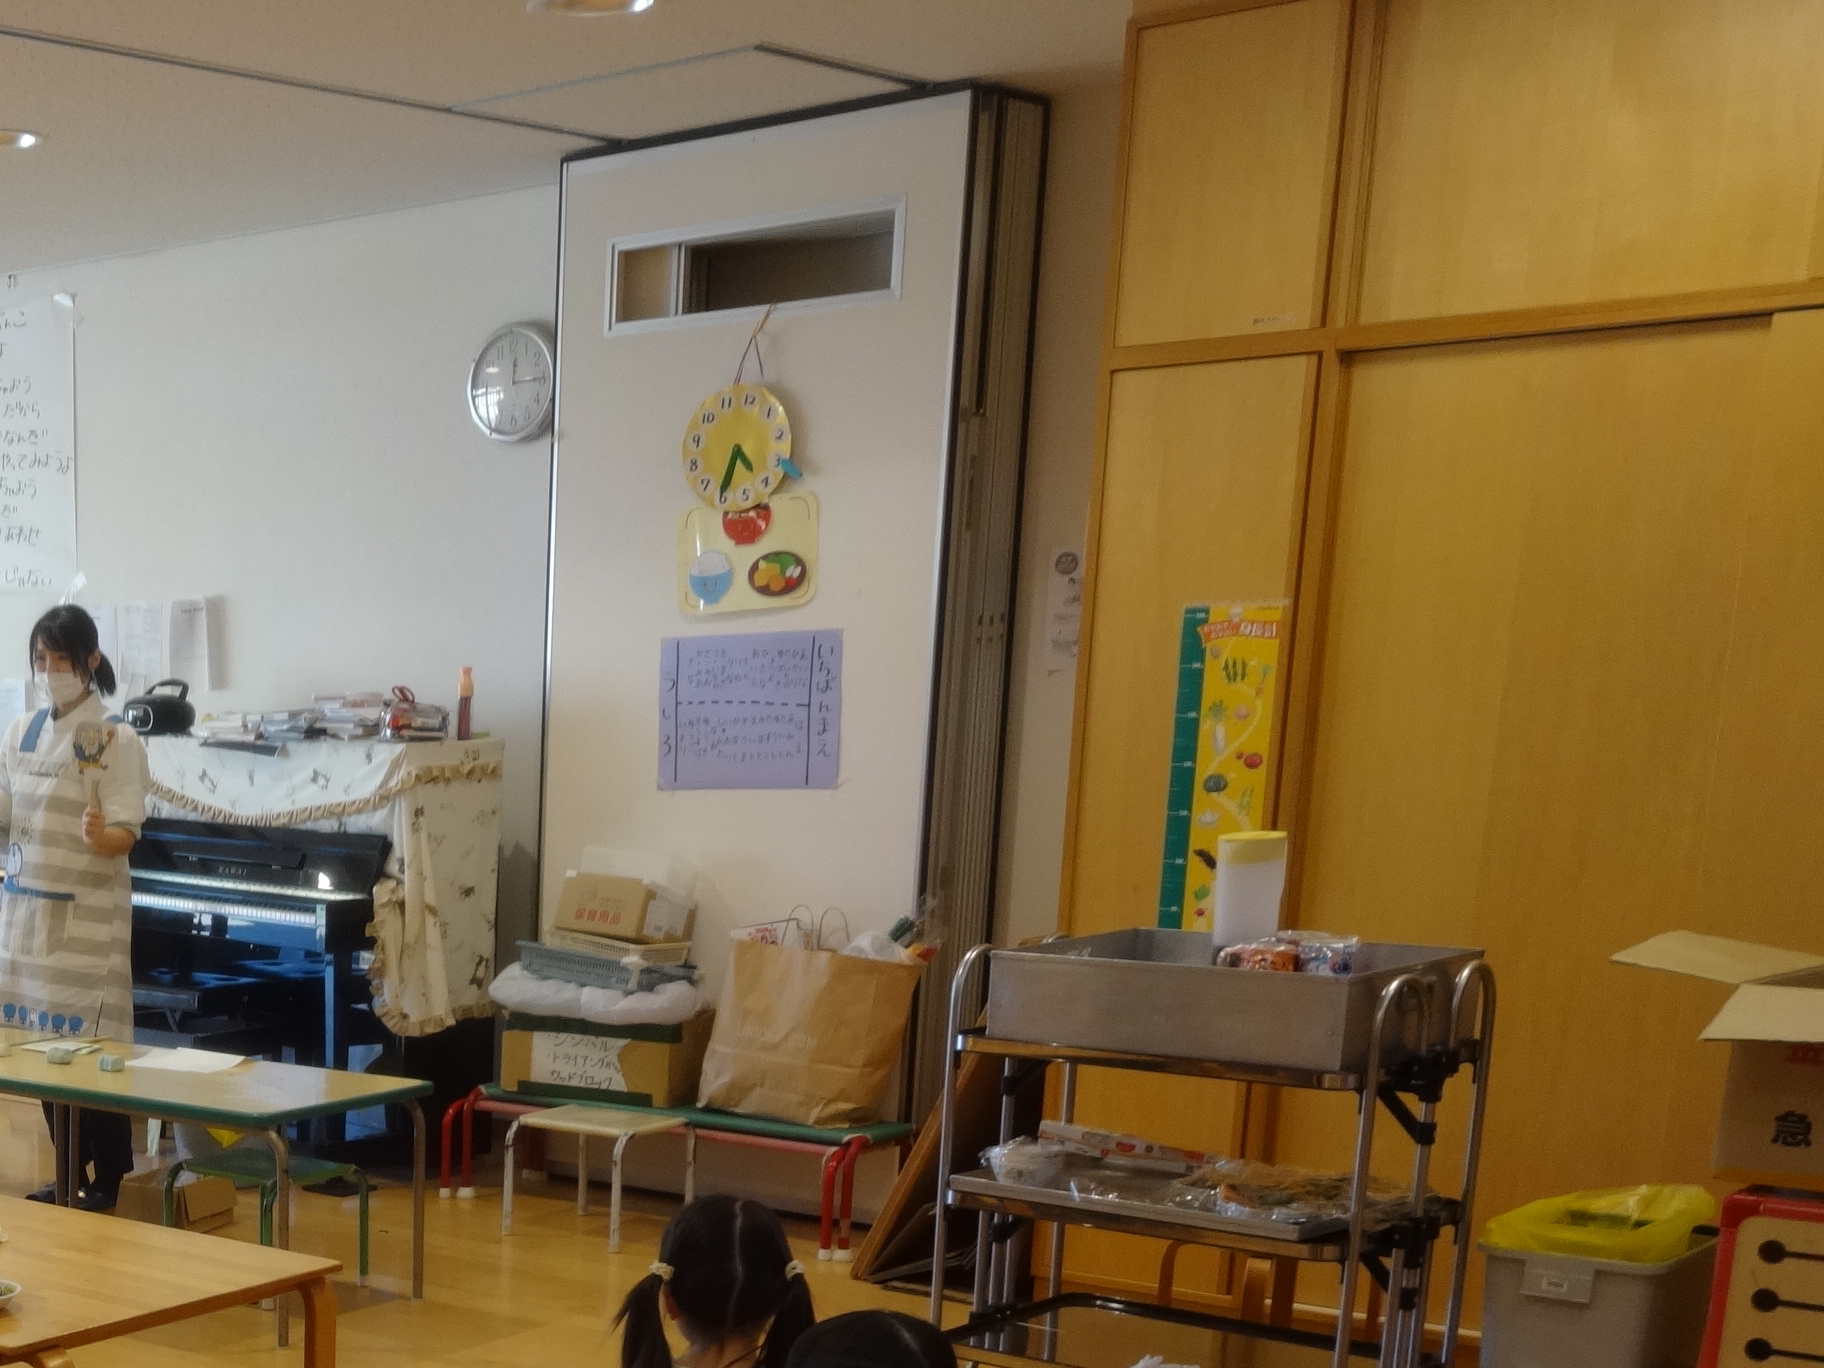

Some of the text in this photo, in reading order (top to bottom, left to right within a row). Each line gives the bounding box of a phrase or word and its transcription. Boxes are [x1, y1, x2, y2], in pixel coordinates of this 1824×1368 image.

[720, 397, 732, 409] 11
[744, 393, 756, 406] 12
[701, 412, 715, 424] 10
[766, 406, 772, 418] 1
[776, 428, 784, 440] 2
[693, 434, 700, 448] 9
[689, 459, 698, 471] 8
[773, 455, 782, 467] 3
[701, 478, 711, 491] 7
[761, 475, 771, 488] 4
[741, 488, 749, 501] 5
[816, 644, 836, 757] いちばんまえ
[662, 670, 676, 756] うしろ
[575, 907, 622, 925] 保育用品
[1771, 1110, 1813, 1148] 急
